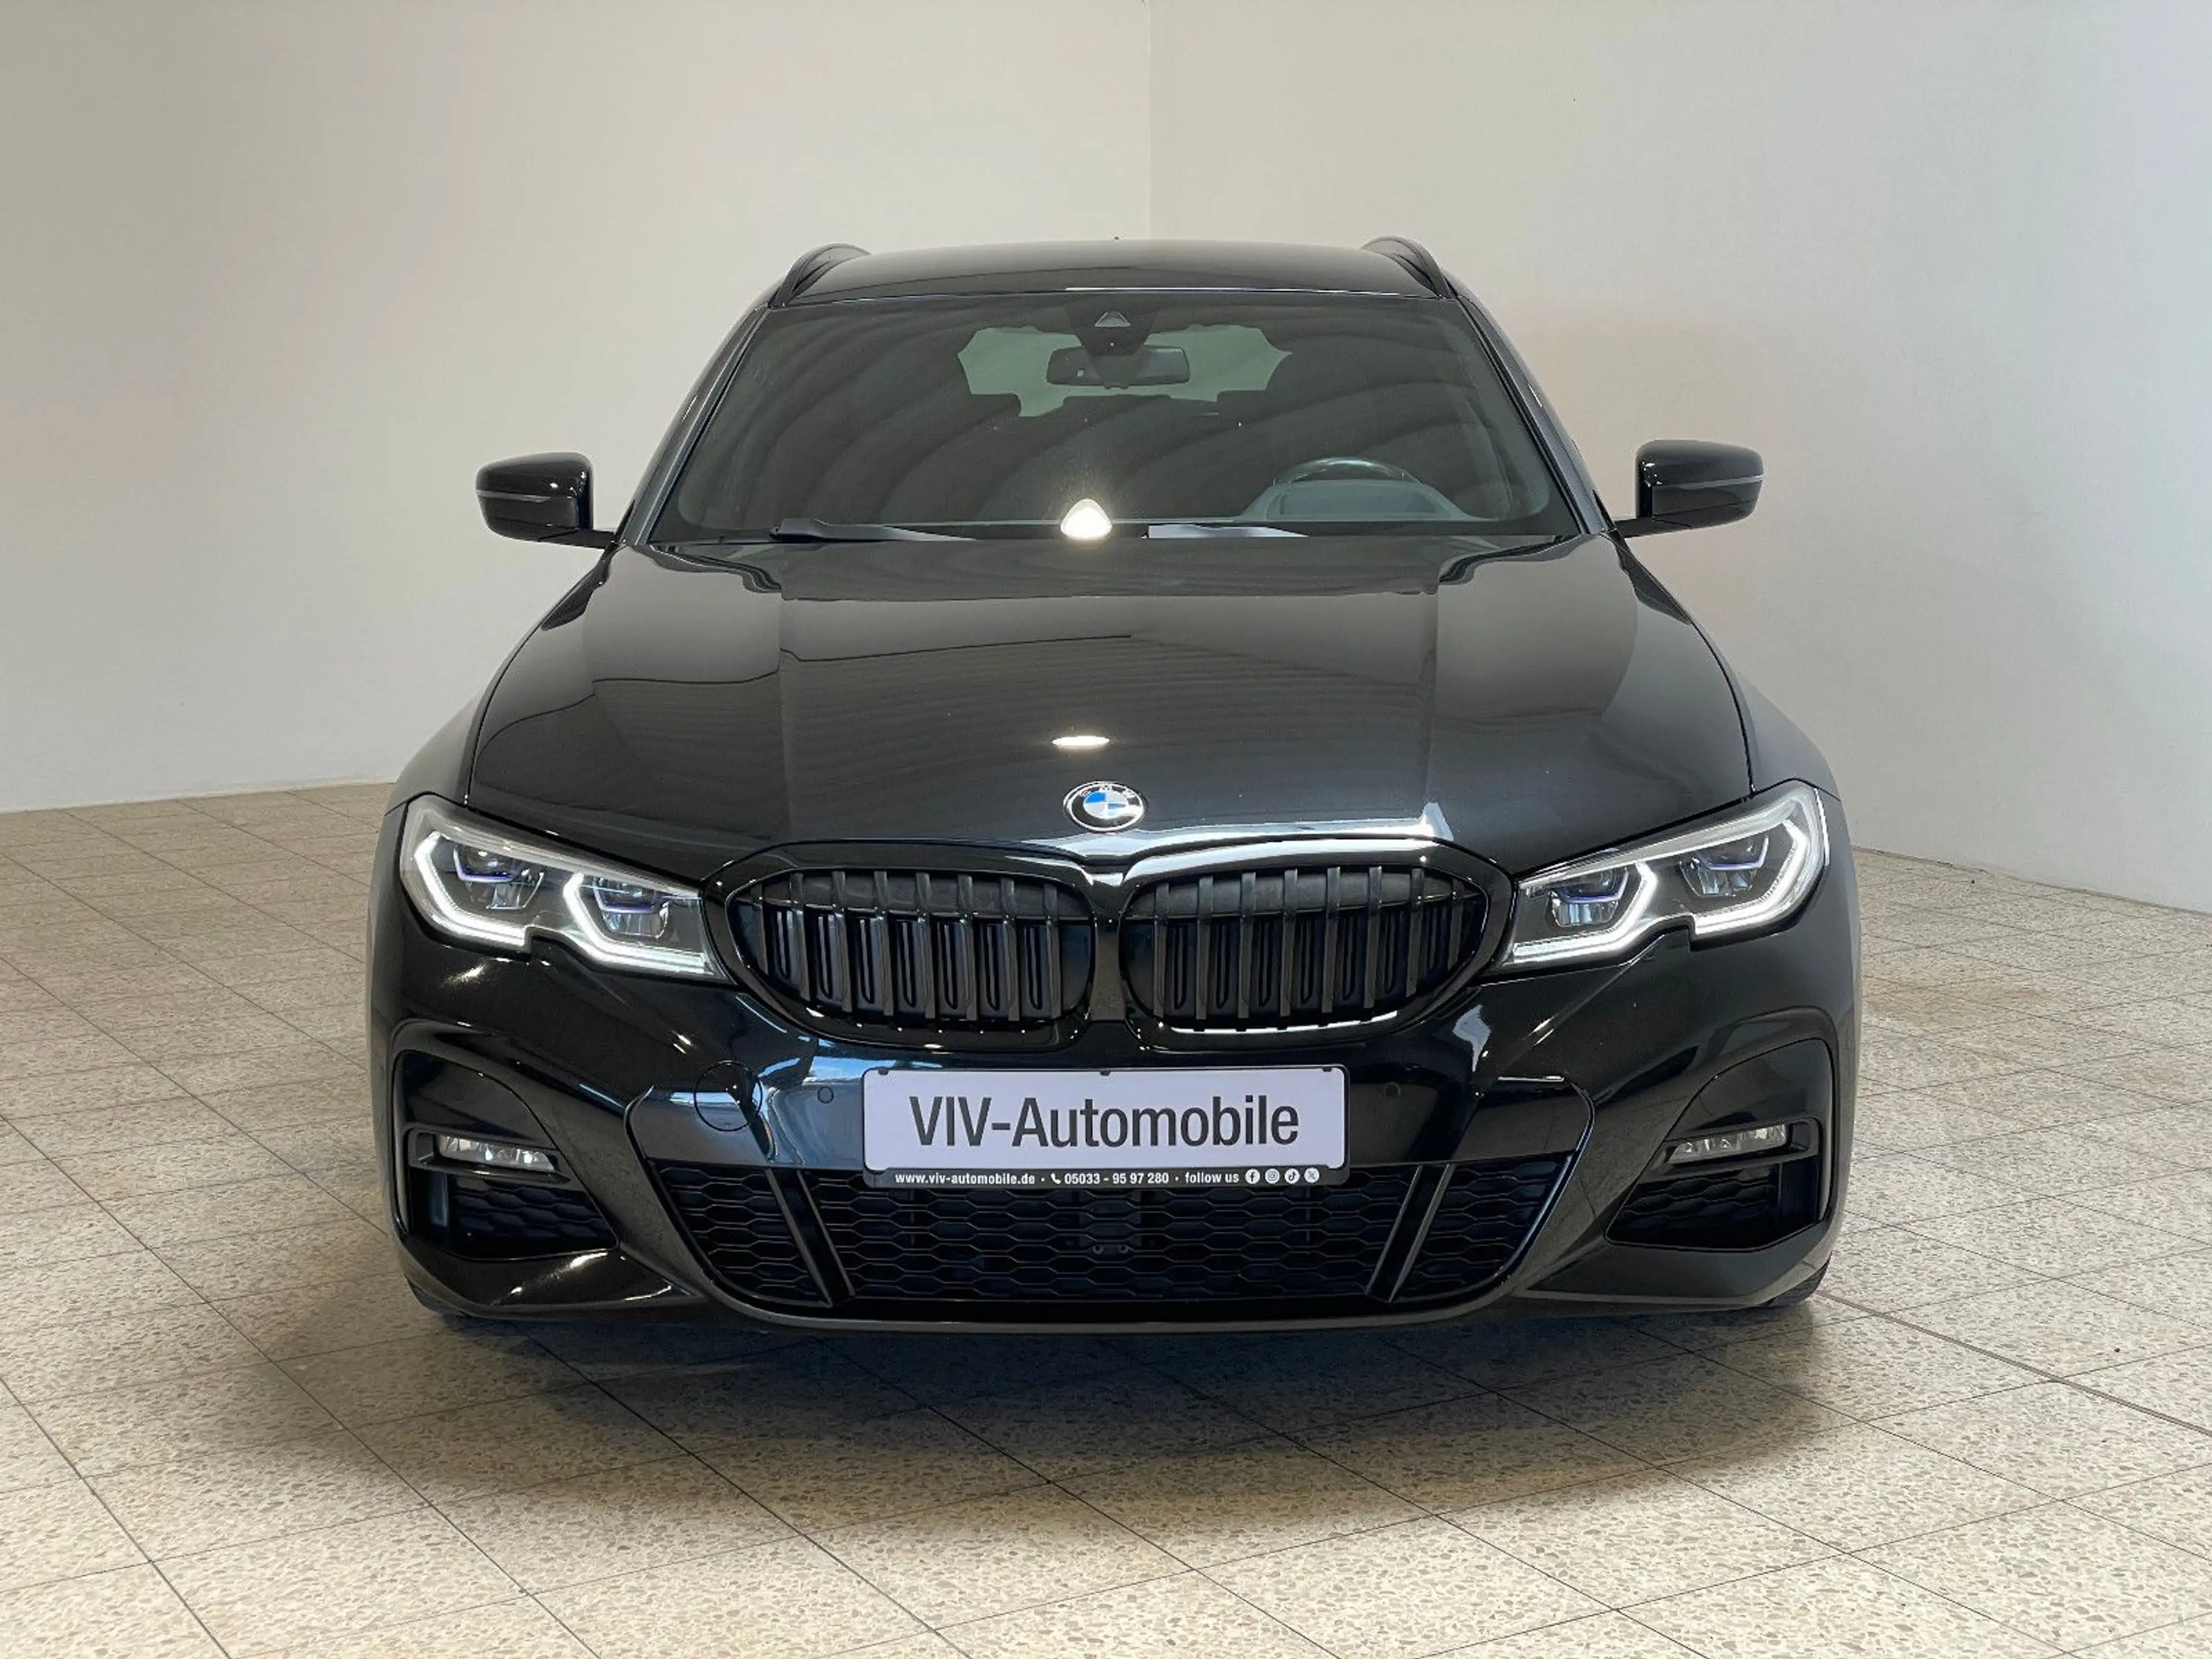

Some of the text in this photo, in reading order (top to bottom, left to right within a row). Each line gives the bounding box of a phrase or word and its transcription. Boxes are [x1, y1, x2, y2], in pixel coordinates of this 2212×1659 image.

[909, 1094, 1299, 1147] VIV-Automobile
[895, 1172, 1036, 1185] www.viv-automobile.de
[1065, 1172, 1100, 1184] 05033
[1112, 1172, 1127, 1184] 95
[1130, 1172, 1145, 1184] 97
[1147, 1172, 1169, 1184] 280
[1184, 1171, 1222, 1184] follow
[1225, 1173, 1240, 1183] us
